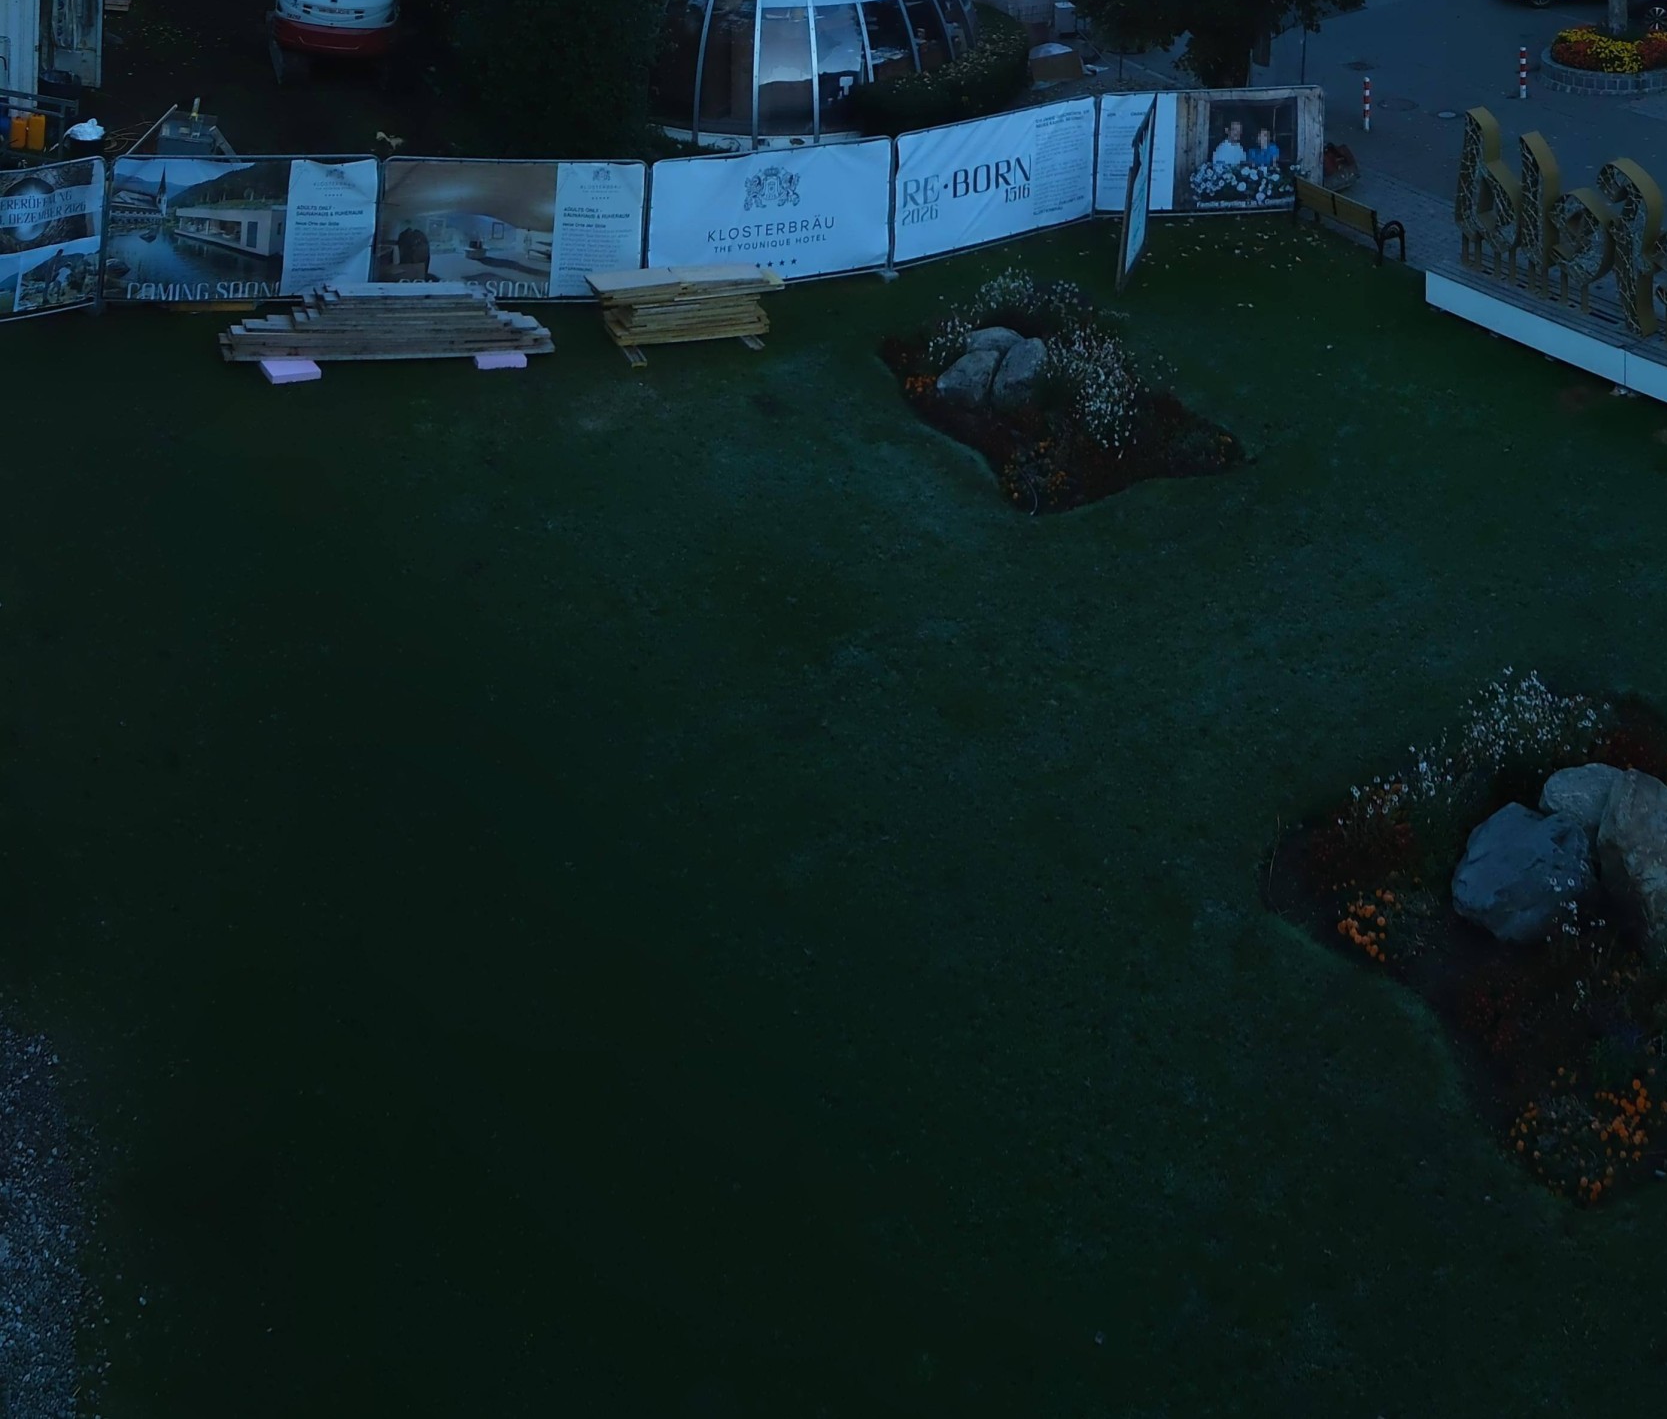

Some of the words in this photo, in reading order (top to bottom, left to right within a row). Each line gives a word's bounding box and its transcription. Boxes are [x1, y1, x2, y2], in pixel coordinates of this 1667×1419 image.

[1005, 184, 1031, 203] 1516
[902, 205, 938, 226] 2026
[707, 214, 835, 242] KLOSTERBRÄU
[737, 239, 791, 251] YOUNIQUE
[795, 234, 827, 244] HOTEL
